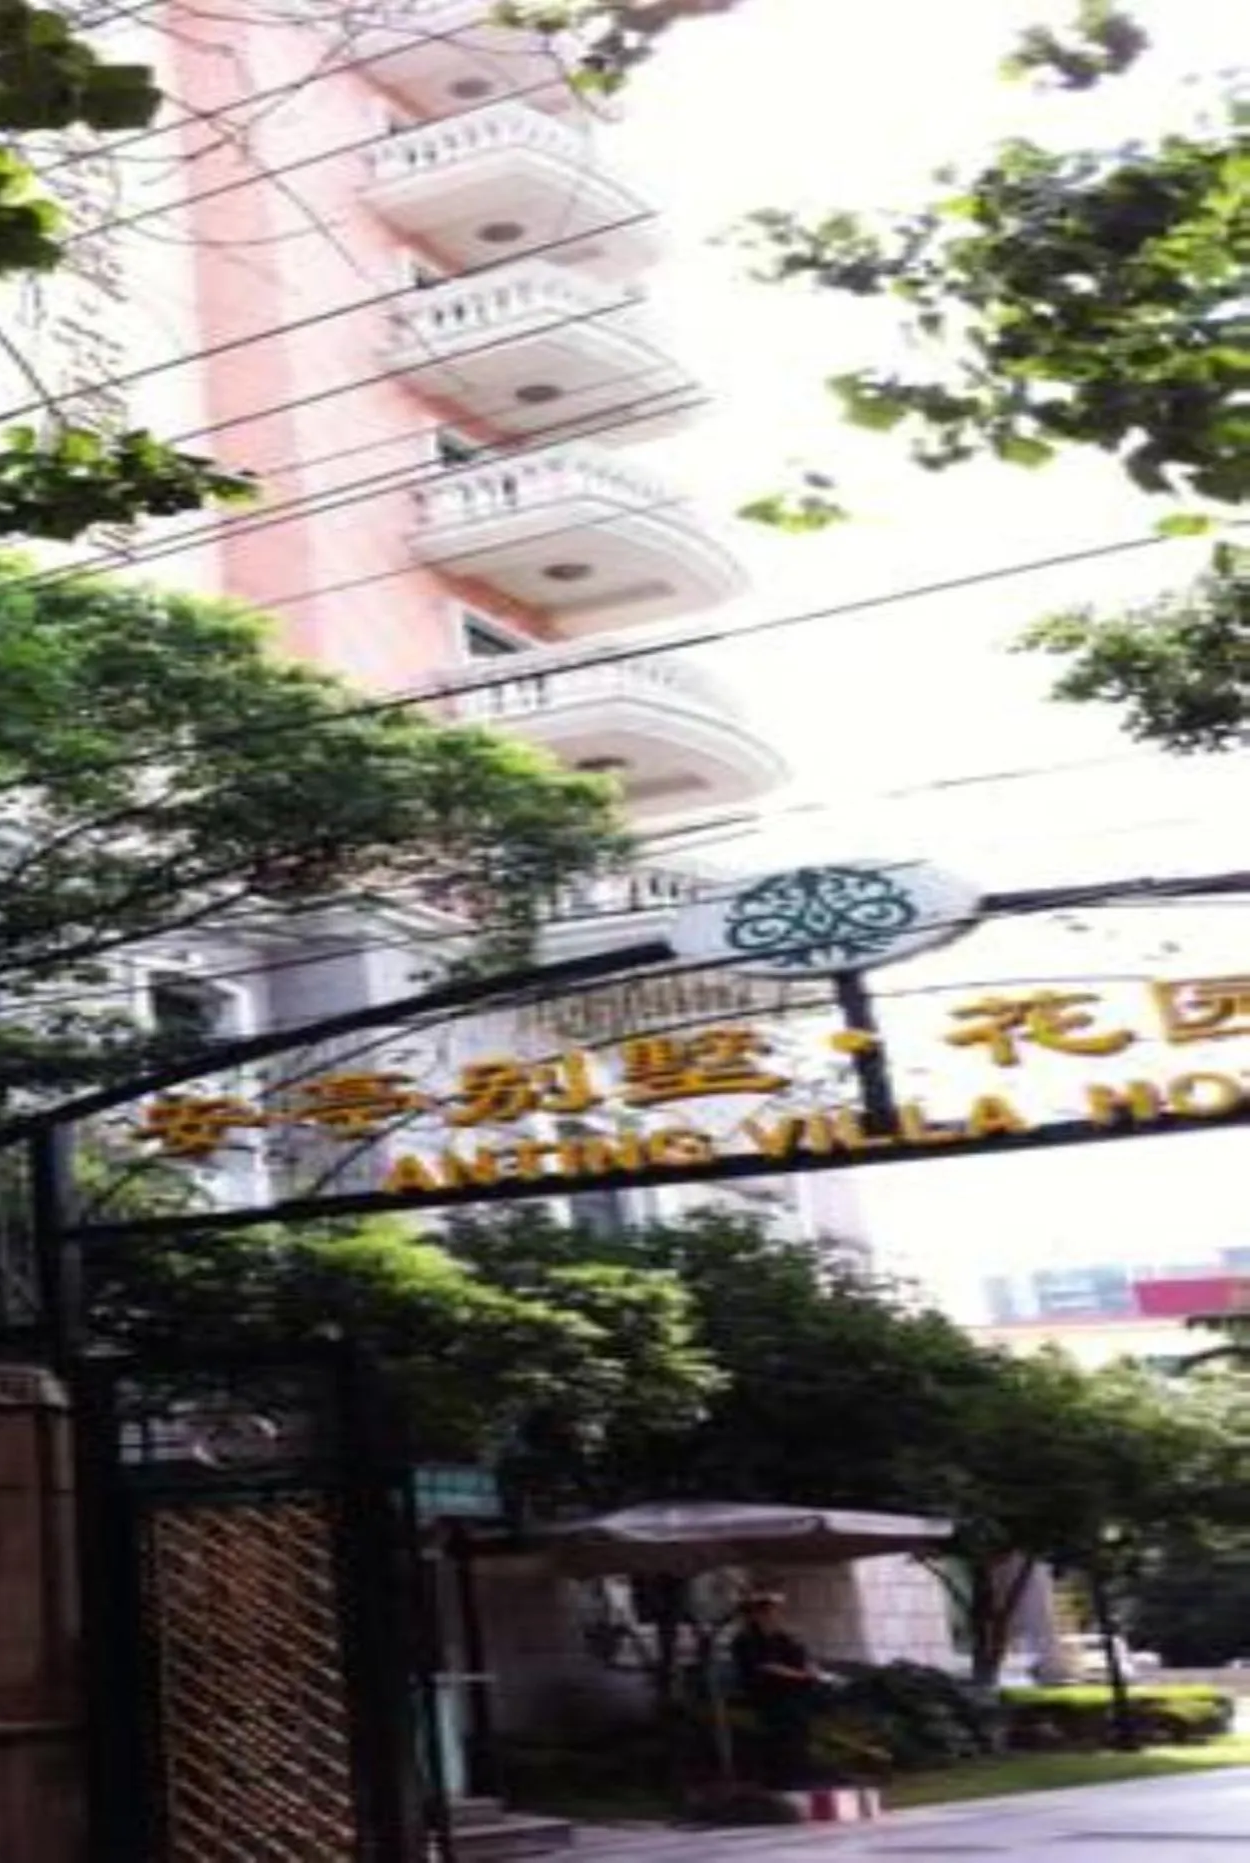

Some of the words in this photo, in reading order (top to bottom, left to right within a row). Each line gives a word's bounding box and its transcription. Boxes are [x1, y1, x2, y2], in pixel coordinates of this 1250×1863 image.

[383, 1127, 714, 1194] ANTING
[740, 1093, 1034, 1158] VILLA
[1085, 1071, 1248, 1130] HO
